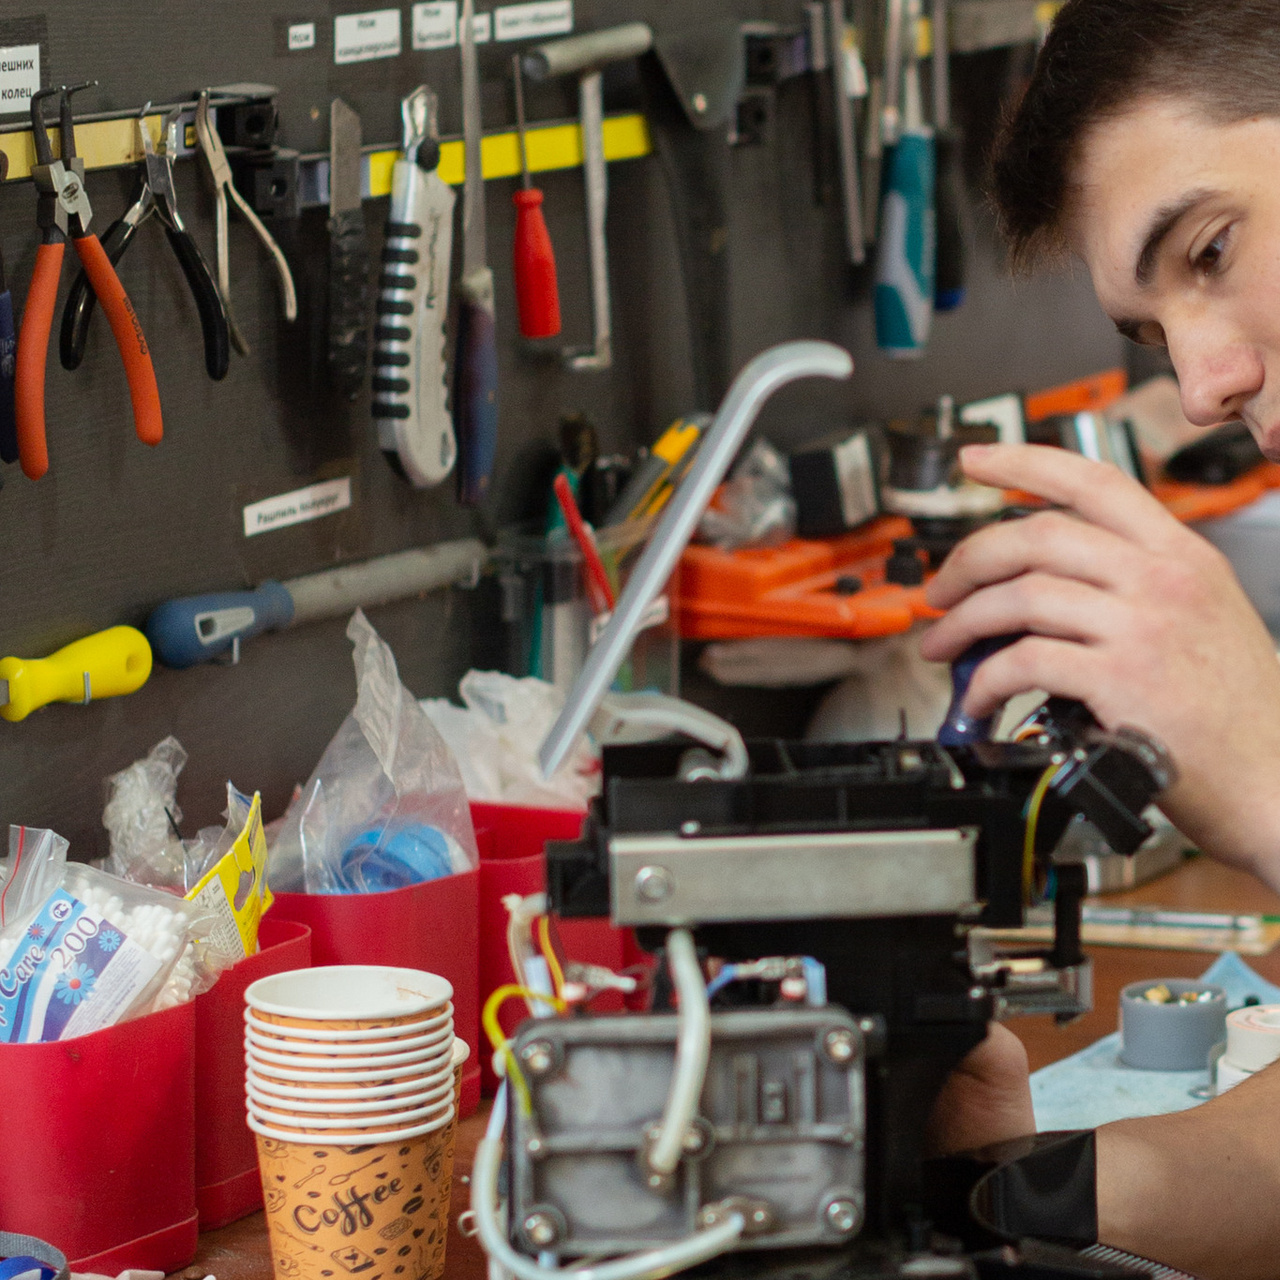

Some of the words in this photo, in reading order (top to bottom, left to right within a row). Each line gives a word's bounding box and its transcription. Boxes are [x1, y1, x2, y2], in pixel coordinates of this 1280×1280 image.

[0, 59, 34, 72] ешних
[1, 87, 33, 100] колец
[50, 915, 99, 971] 200
[0, 945, 45, 999] Care
[293, 1176, 406, 1238] Coffee
